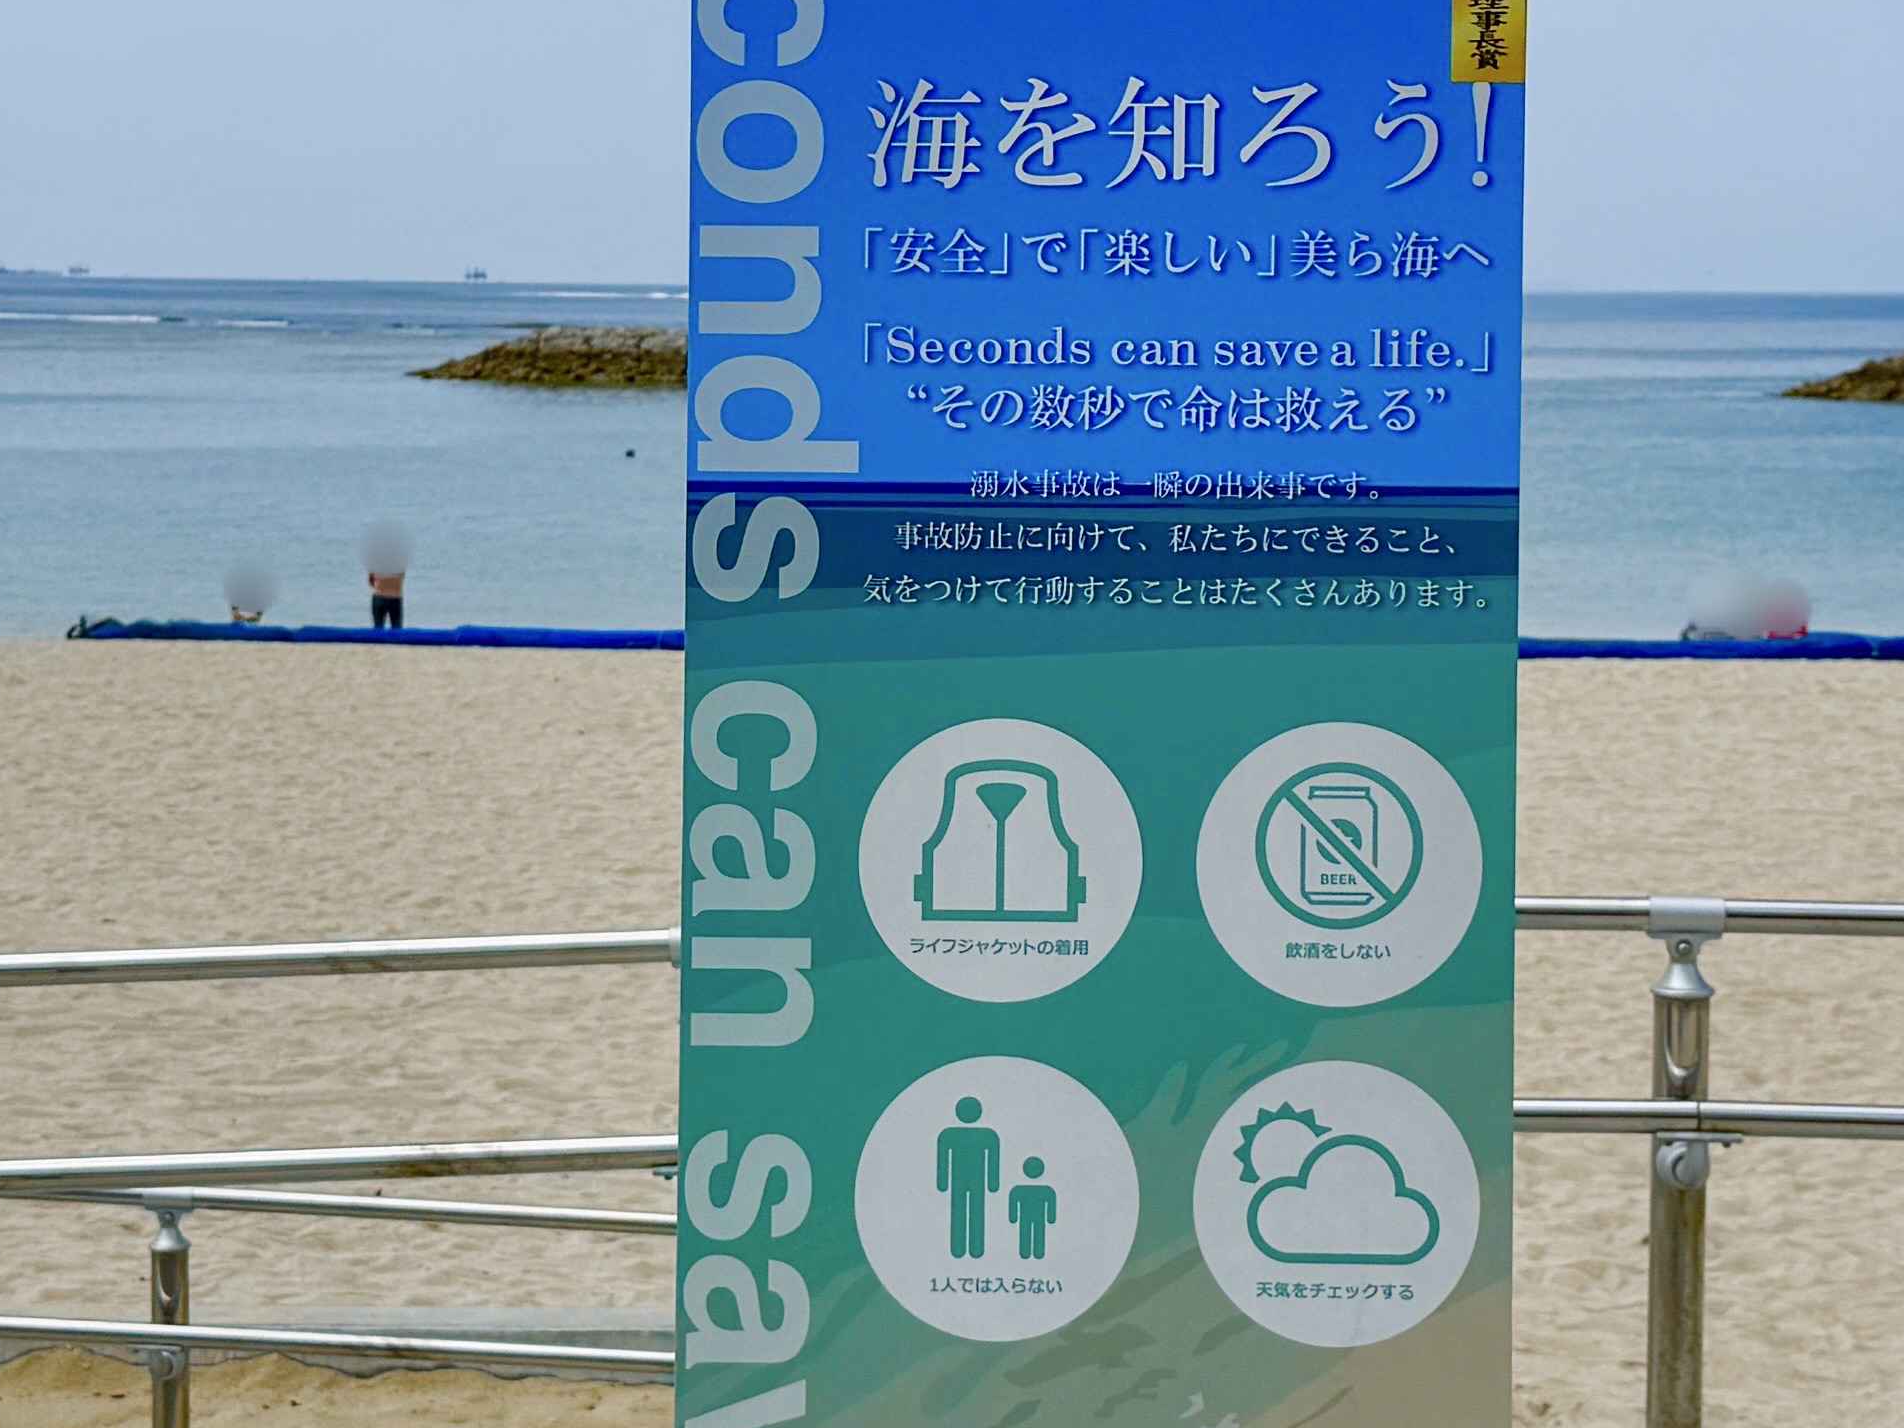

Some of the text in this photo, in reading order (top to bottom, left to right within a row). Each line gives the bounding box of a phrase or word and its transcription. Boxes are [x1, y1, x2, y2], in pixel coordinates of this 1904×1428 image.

[863, 226, 1491, 279] 「安全」で「楽しい」美ら海へ
[1111, 333, 1199, 368] can
[1212, 333, 1321, 369] save
[1331, 333, 1356, 369] a
[969, 469, 1387, 502] 溺水事故は一瞬の出来事です。
[893, 520, 1459, 556] 事故防止に向けて、私たちにできること、
[862, 574, 1492, 611] 気をつけて行動することはたくさんあります。
[689, 679, 819, 1048] can
[1319, 872, 1358, 888] BEER
[908, 936, 1091, 959] ライフジャケットの着用
[1284, 940, 1393, 962] 飲酒をしない
[928, 1275, 1064, 1297] 1人では入らない
[1255, 1280, 1416, 1303] 天気をチェックする
